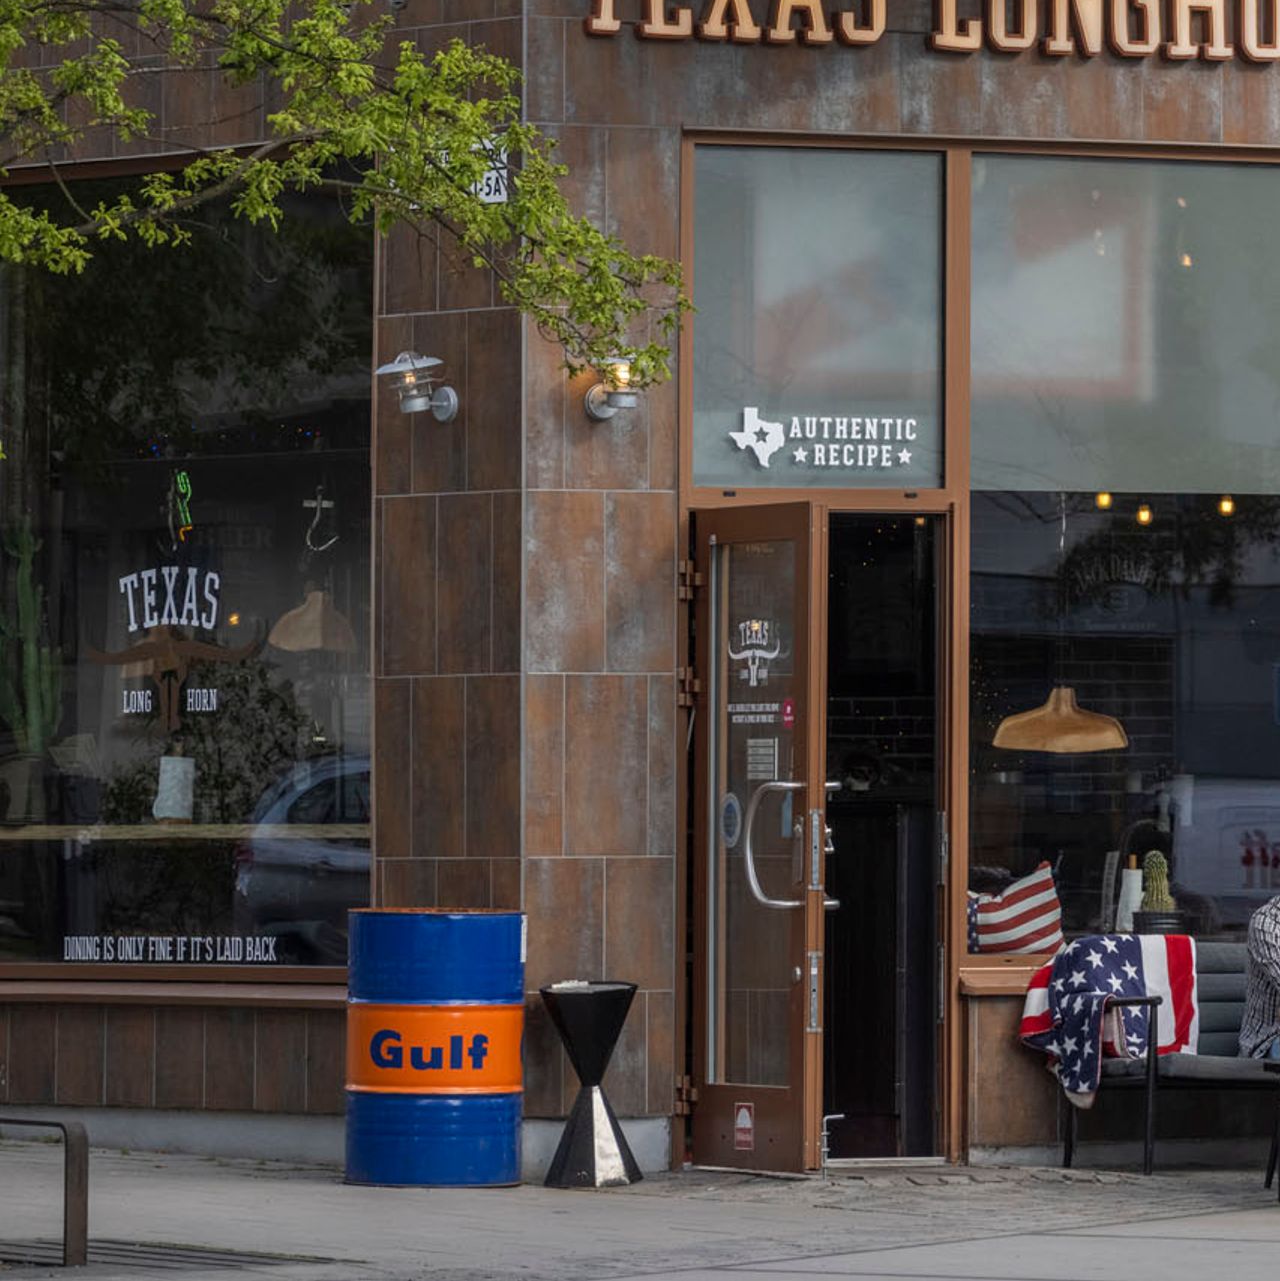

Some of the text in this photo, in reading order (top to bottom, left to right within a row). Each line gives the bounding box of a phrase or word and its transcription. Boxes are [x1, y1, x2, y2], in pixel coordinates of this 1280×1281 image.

[789, 416, 918, 441] AUTHENTIC
[813, 443, 893, 467] RECIPE
[119, 566, 221, 633] TEXAS
[123, 688, 218, 714] LONG HORN
[64, 936, 277, 961] DINING IS ONLY FINE IF IT'S LAID BACK
[370, 1029, 490, 1070] Gulf
